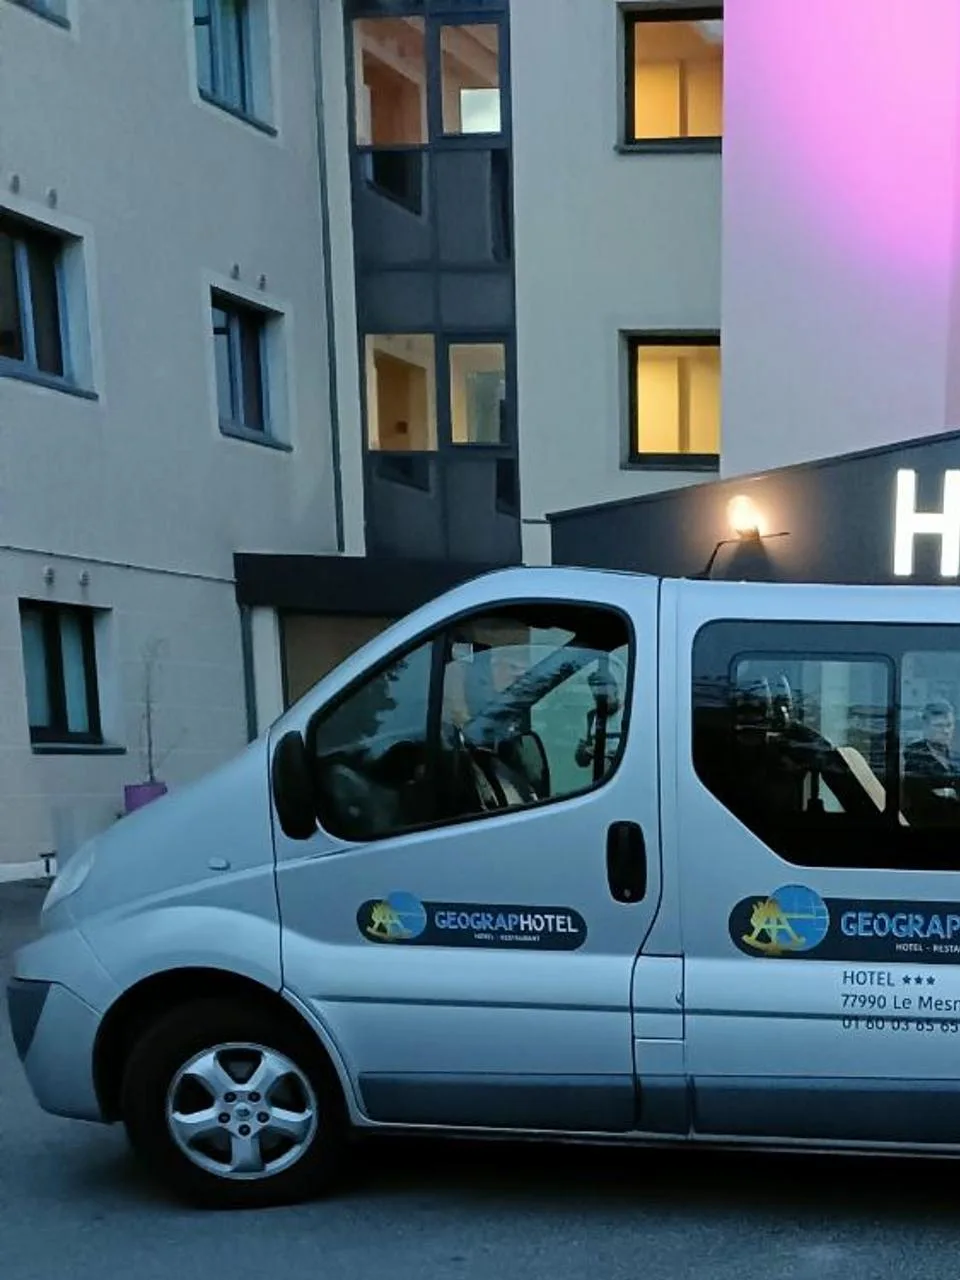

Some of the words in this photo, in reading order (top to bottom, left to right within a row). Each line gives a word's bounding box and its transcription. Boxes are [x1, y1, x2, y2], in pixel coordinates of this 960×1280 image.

[434, 911, 579, 933] GEOGRAPHOTEL
[895, 943, 923, 952] HOTEL
[842, 971, 895, 987] HOTEL
[841, 994, 887, 1009] 77990
[894, 995, 912, 1010] Le
